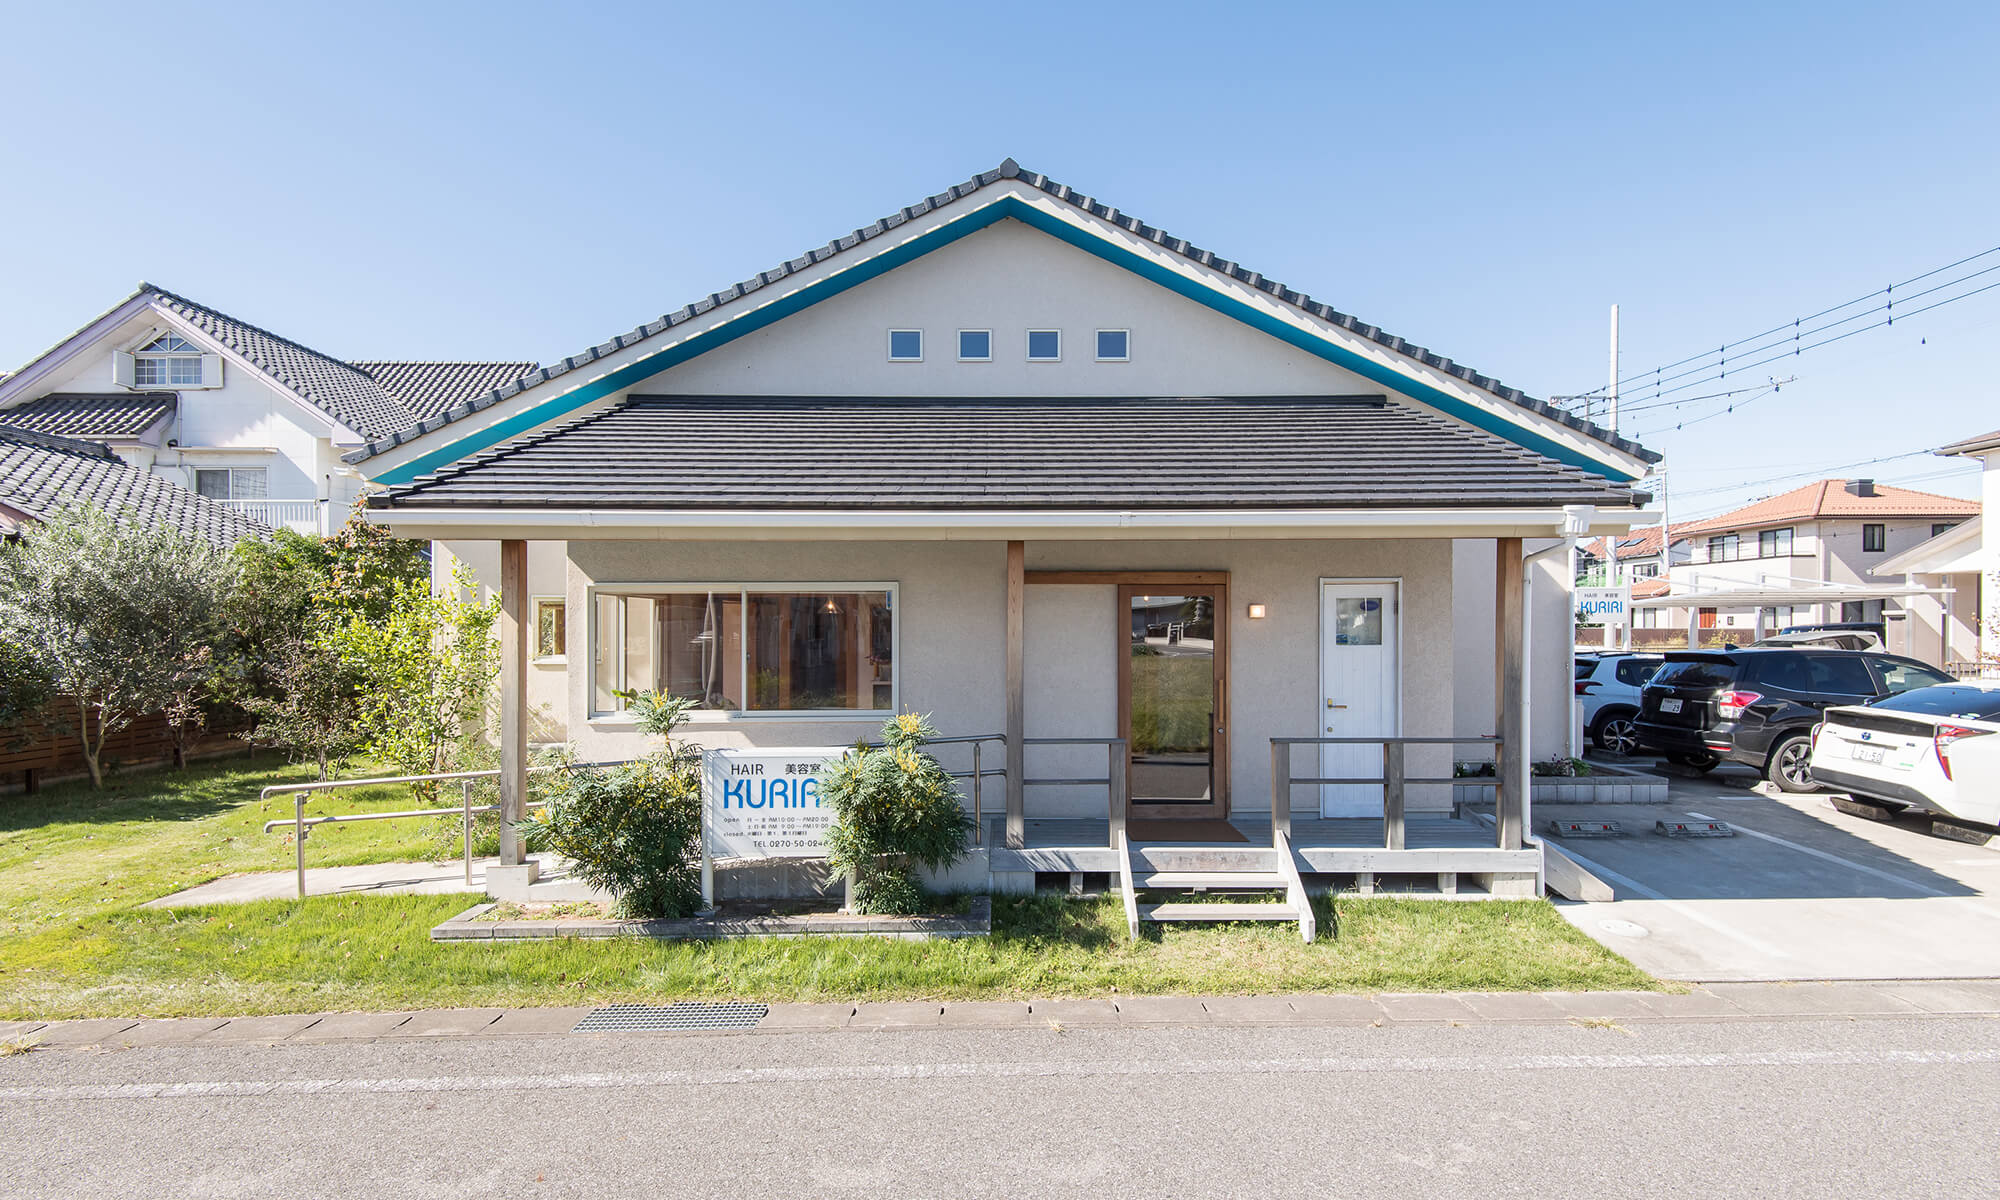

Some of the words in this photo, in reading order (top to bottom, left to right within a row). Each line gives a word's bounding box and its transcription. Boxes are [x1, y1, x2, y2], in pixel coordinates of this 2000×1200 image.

[1580, 601, 1622, 613] KURIRI
[731, 763, 764, 775] HAIR
[785, 763, 821, 775] 美容室
[723, 778, 829, 809] KURIR
